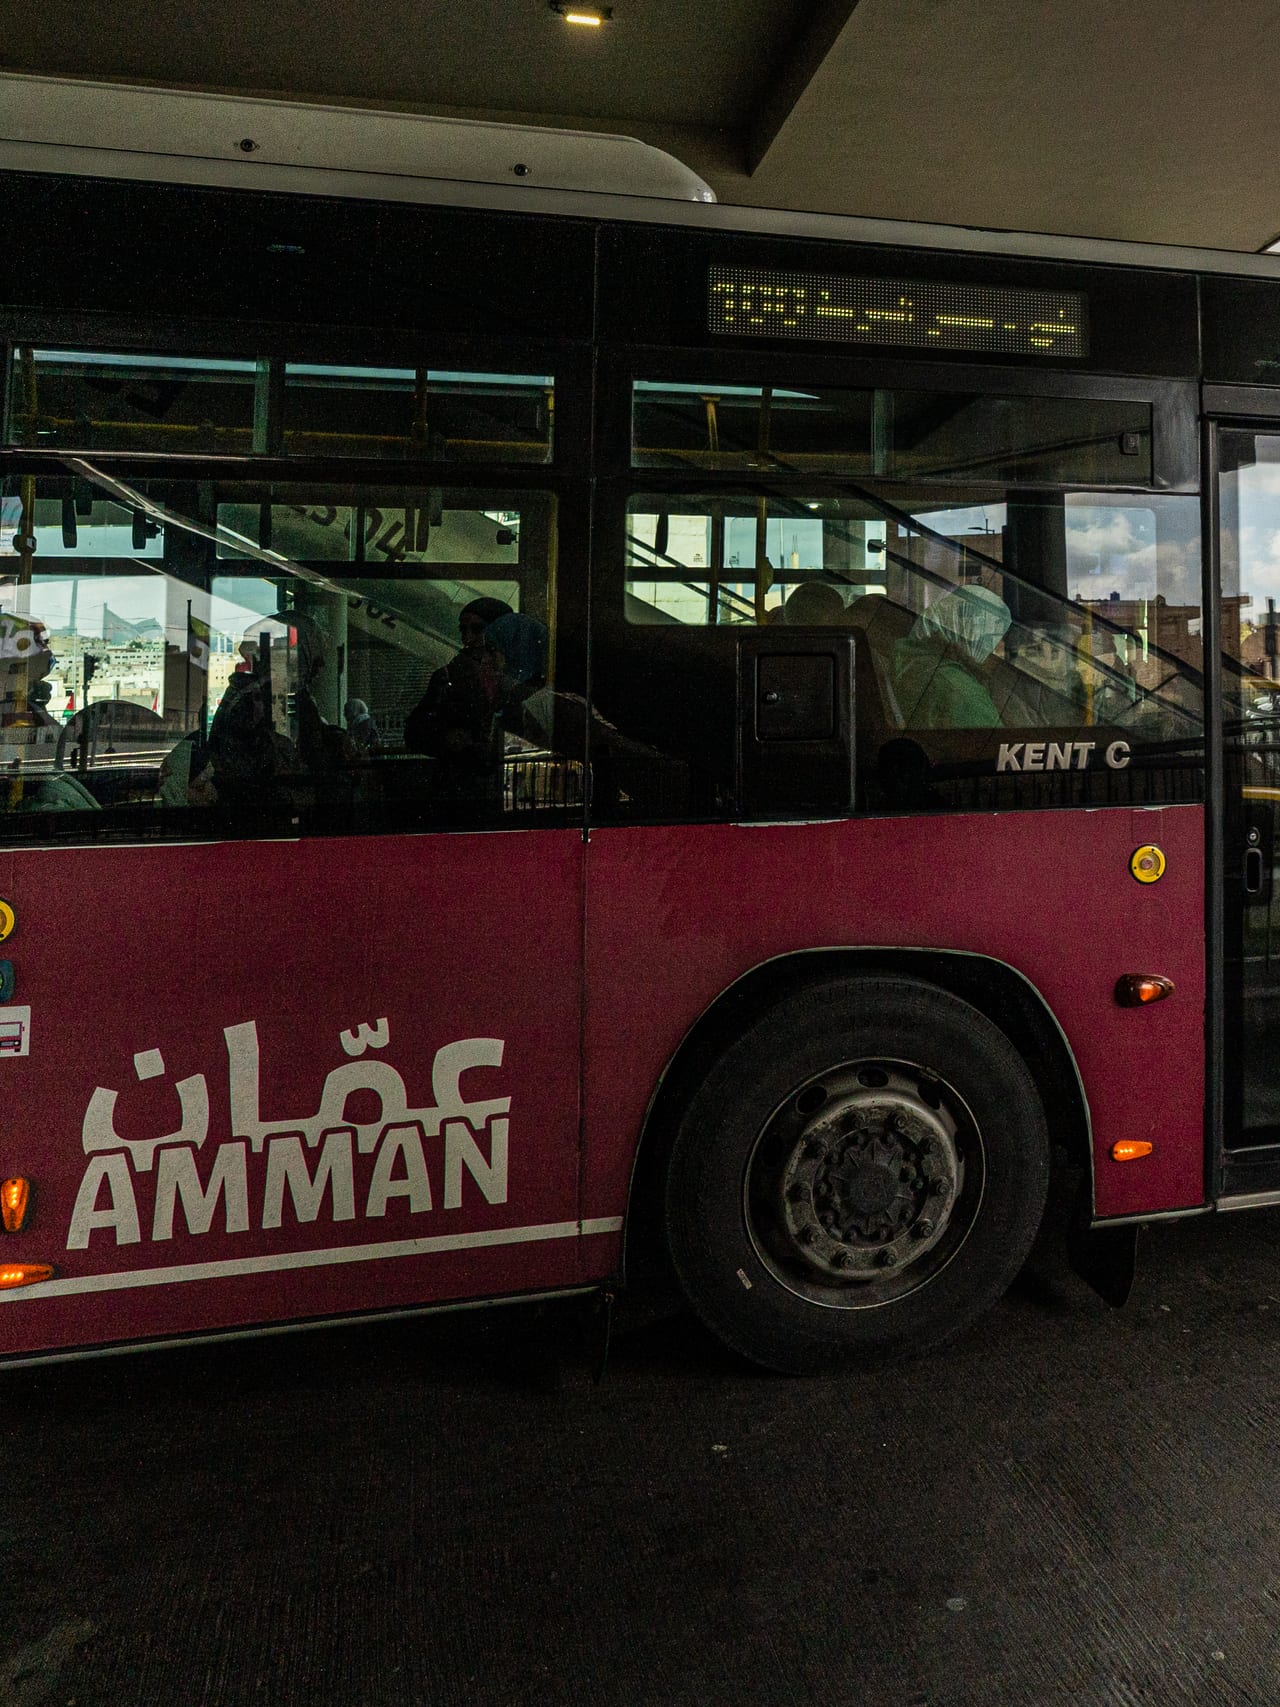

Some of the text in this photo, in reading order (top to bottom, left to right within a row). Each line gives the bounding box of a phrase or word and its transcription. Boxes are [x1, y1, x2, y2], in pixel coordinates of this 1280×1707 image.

[996, 740, 1131, 772] KENT C
[66, 1116, 510, 1250] AMMAN
